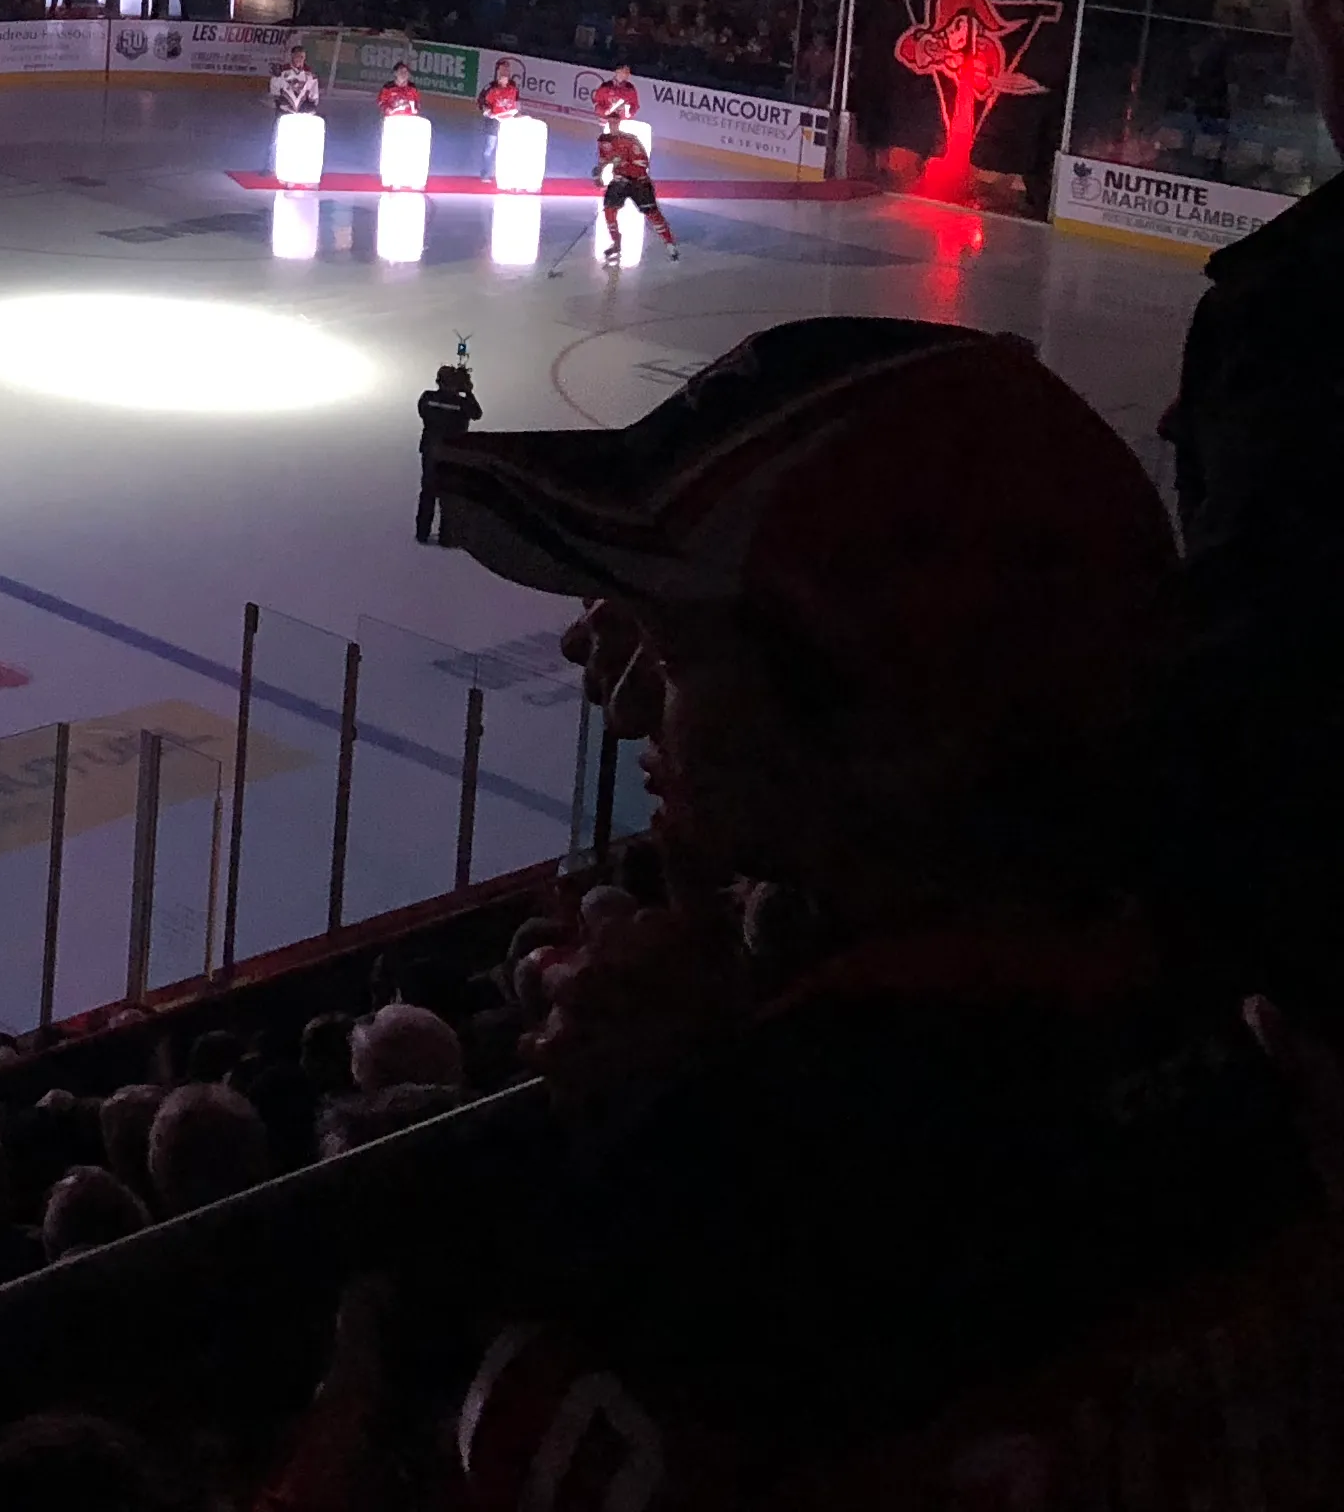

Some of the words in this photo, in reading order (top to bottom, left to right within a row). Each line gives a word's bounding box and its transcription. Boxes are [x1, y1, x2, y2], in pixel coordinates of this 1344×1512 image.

[191, 23, 217, 42] LES
[653, 84, 793, 127] VAILLANCOURT
[1101, 190, 1169, 217] MARIO
[1104, 169, 1209, 207] NUTRITE
